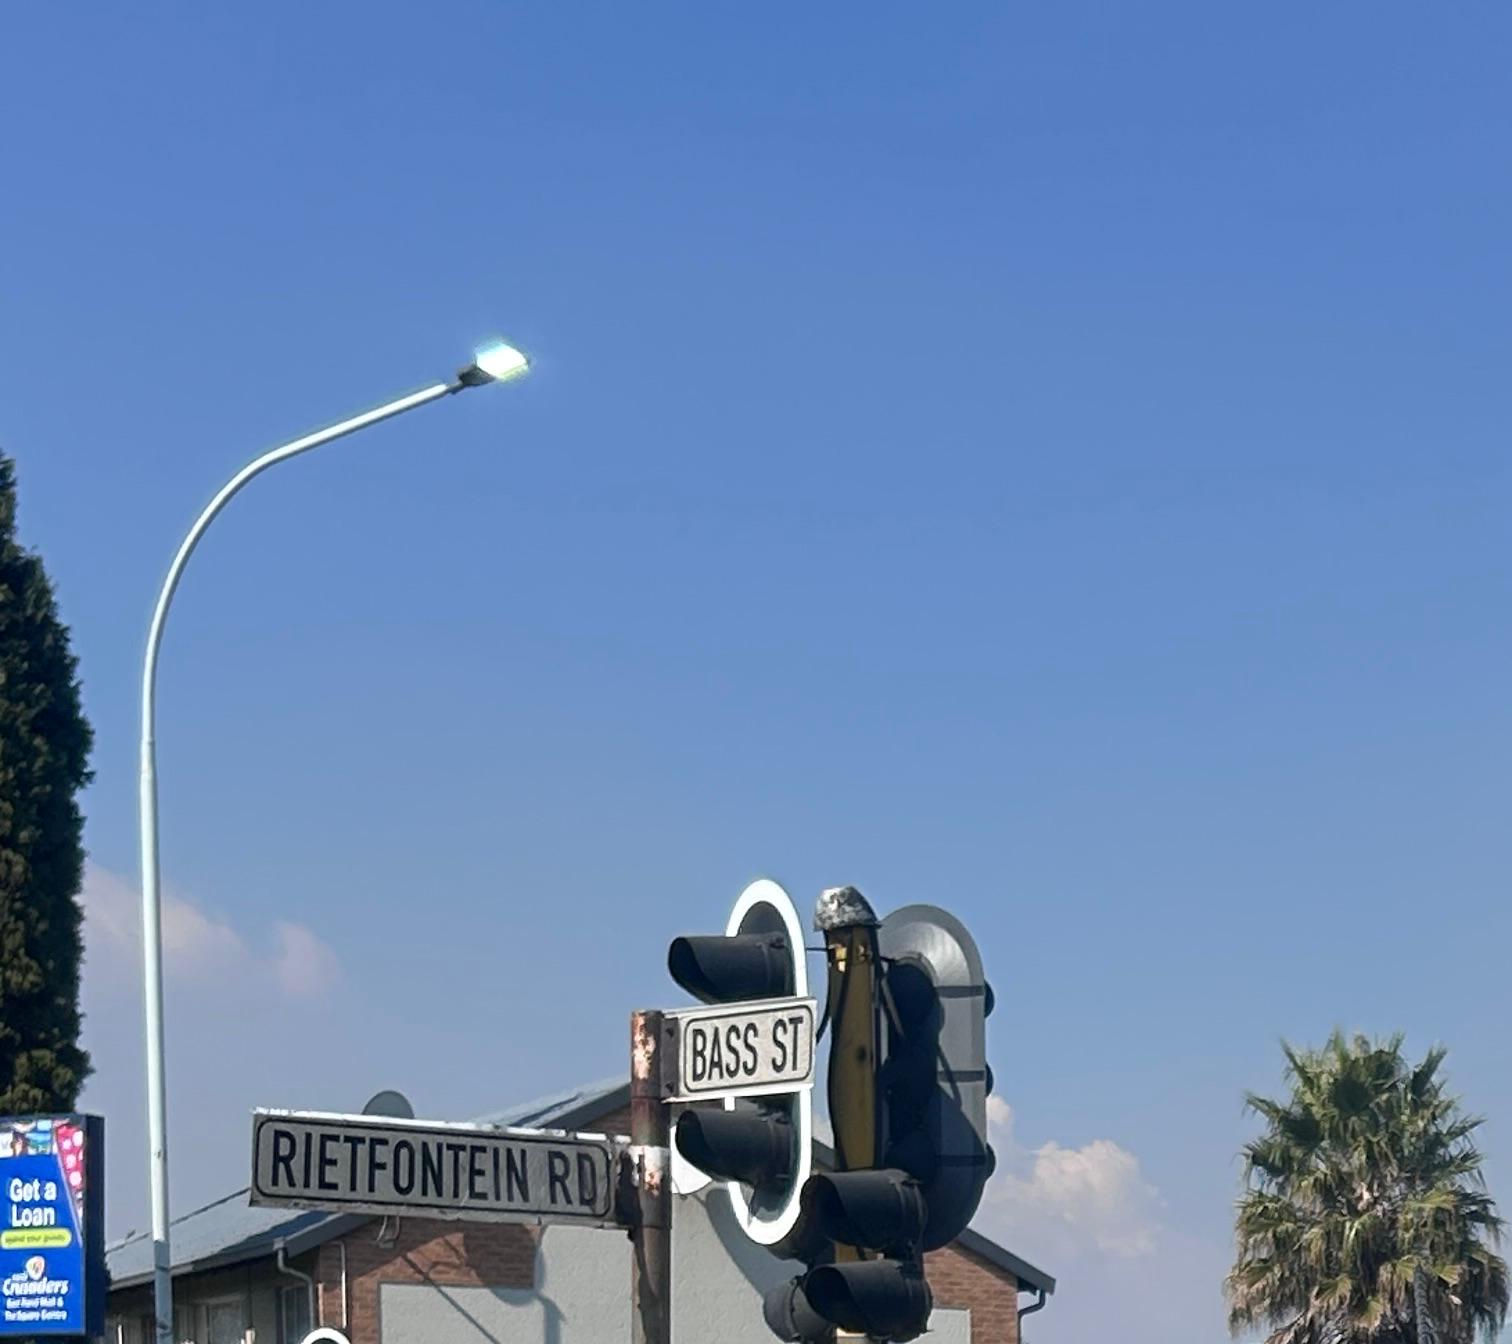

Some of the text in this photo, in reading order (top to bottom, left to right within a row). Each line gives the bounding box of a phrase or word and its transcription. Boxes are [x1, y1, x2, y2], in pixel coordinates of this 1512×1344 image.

[691, 1016, 804, 1083] BASS ST
[9, 1177, 57, 1202] Get a
[271, 1129, 597, 1208] RIETFONTEIN RD
[11, 1203, 56, 1227] Loan
